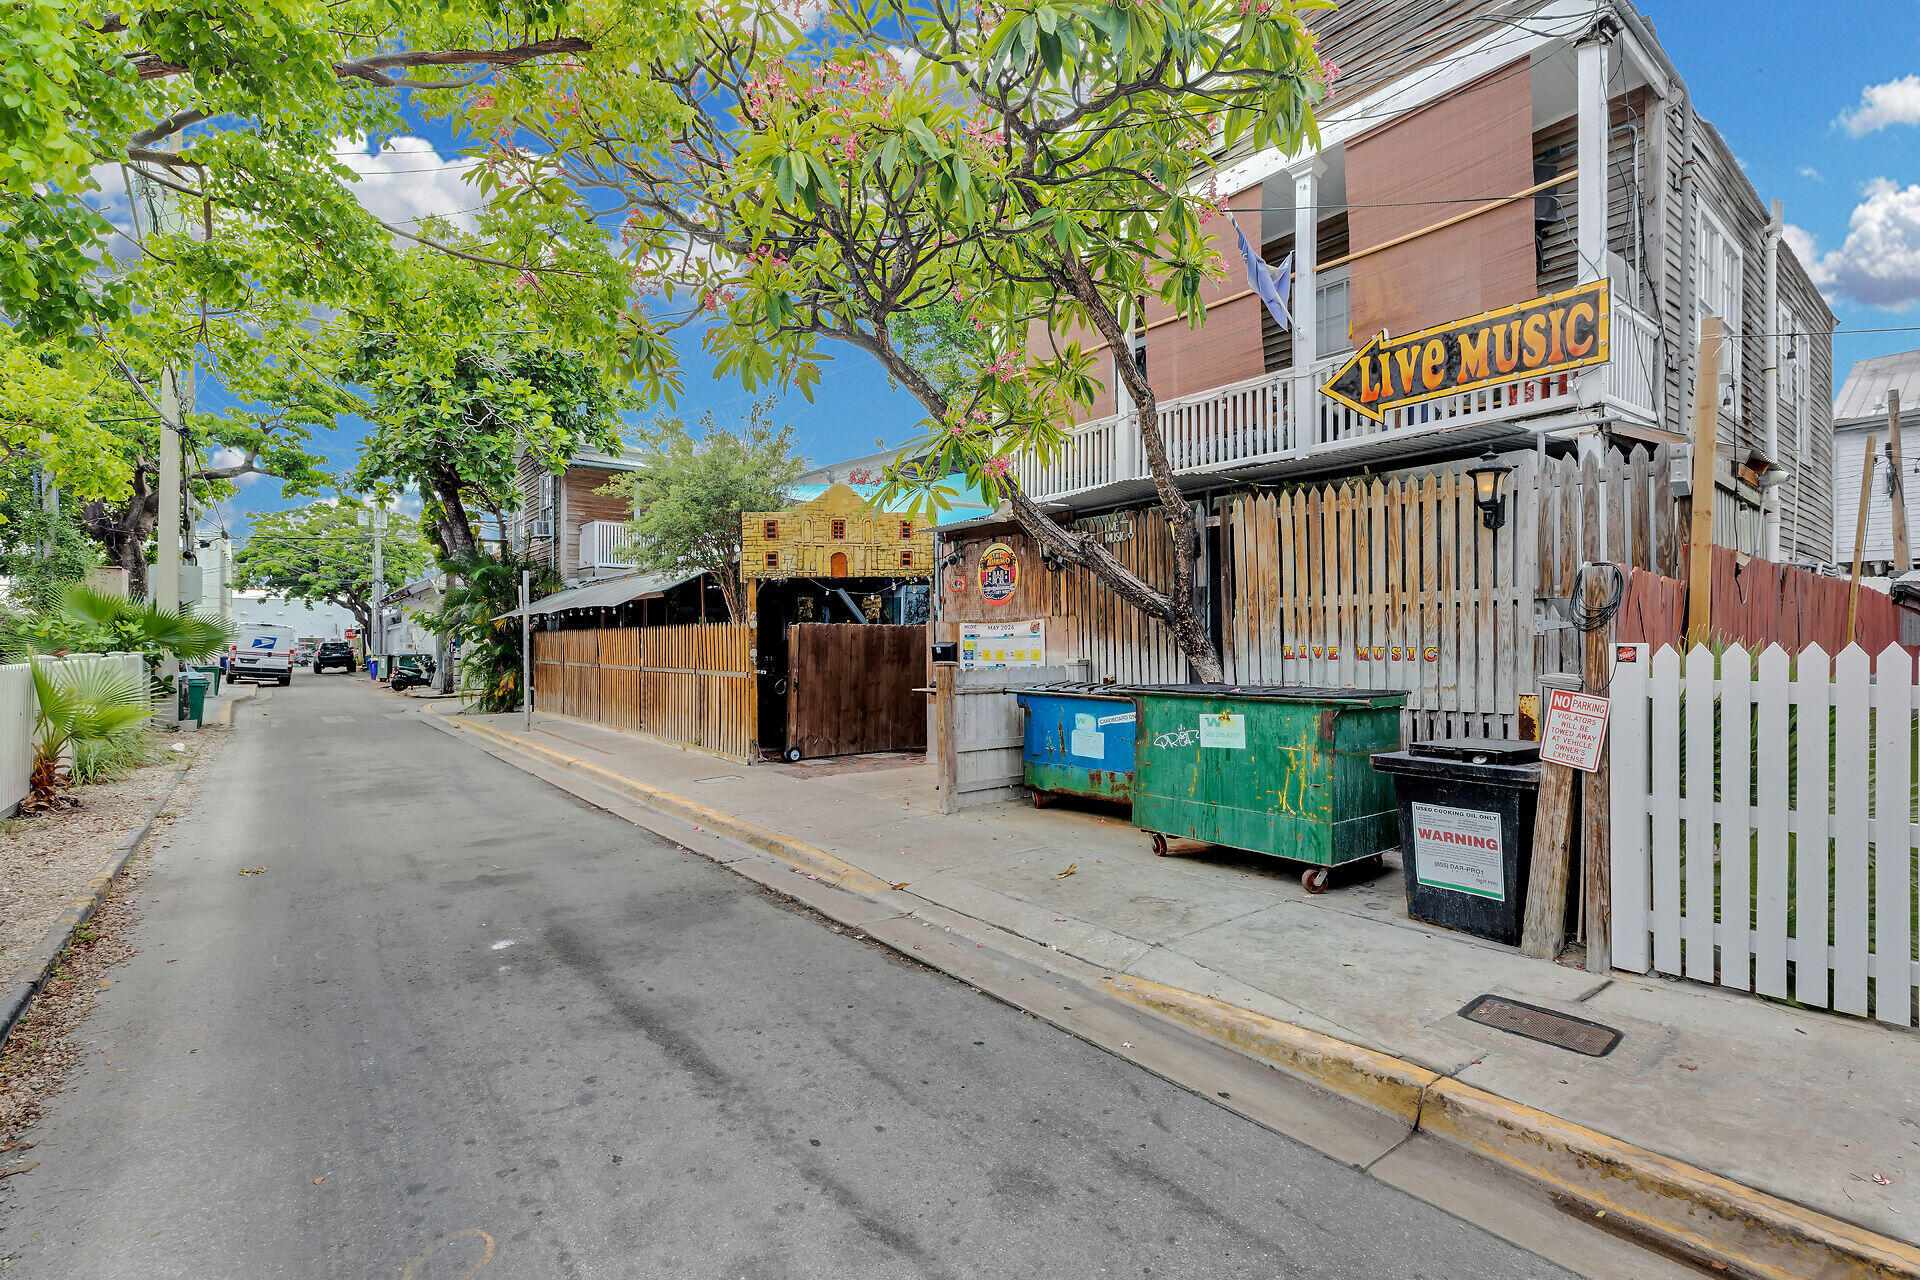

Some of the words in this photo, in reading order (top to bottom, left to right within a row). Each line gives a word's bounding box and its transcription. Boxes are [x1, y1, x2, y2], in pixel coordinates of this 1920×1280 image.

[1457, 302, 1594, 384] MUSIC
[1105, 532, 1127, 542] MUSIC
[1284, 646, 1339, 660] LIVE
[1357, 646, 1439, 662] MUSIC
[1553, 694, 1571, 709] NO
[1572, 700, 1606, 714] PARKING
[1557, 712, 1597, 726] VIOLATORS
[1561, 721, 1577, 730] WILL
[1551, 726, 1575, 737] TOWED
[1576, 732, 1597, 742] AWAY
[1554, 743, 1586, 756] OWNER'S
[1563, 737, 1593, 750] VEHICLE
[1552, 752, 1585, 764] EXPENSE
[1433, 808, 1464, 817] COOKING
[1418, 827, 1499, 851] WARNING
[1450, 863, 1484, 875] DAR-PRO1
